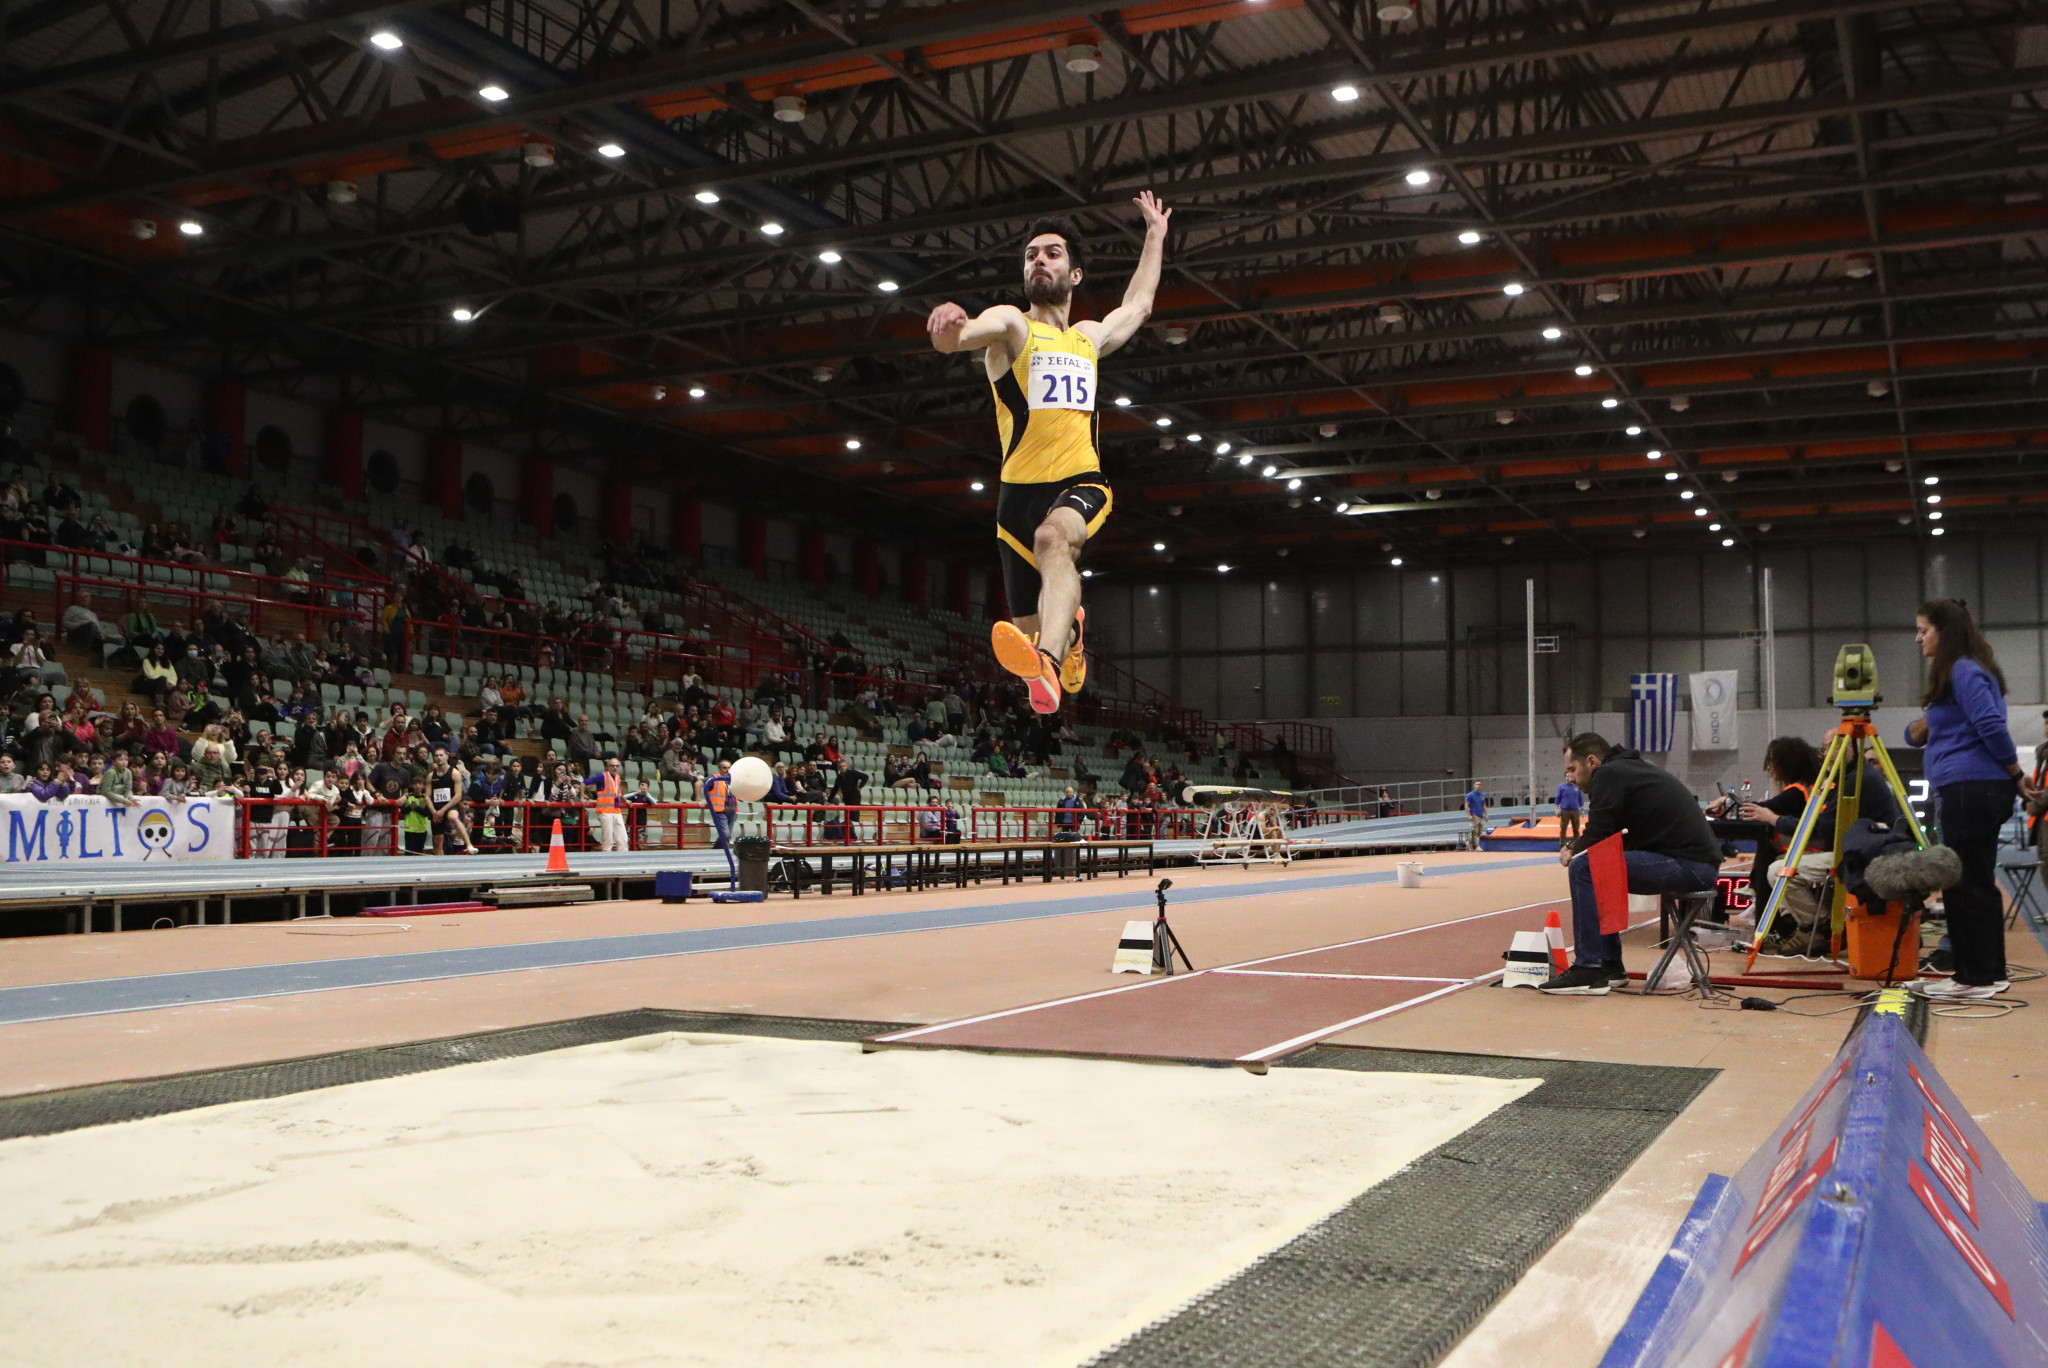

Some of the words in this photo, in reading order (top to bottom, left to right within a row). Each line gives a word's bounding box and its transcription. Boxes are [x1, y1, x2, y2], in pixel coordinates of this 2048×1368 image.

[1047, 356, 1081, 368] ΣΕΓΑΣ
[1042, 374, 1088, 404] 215
[436, 793, 447, 801] 216
